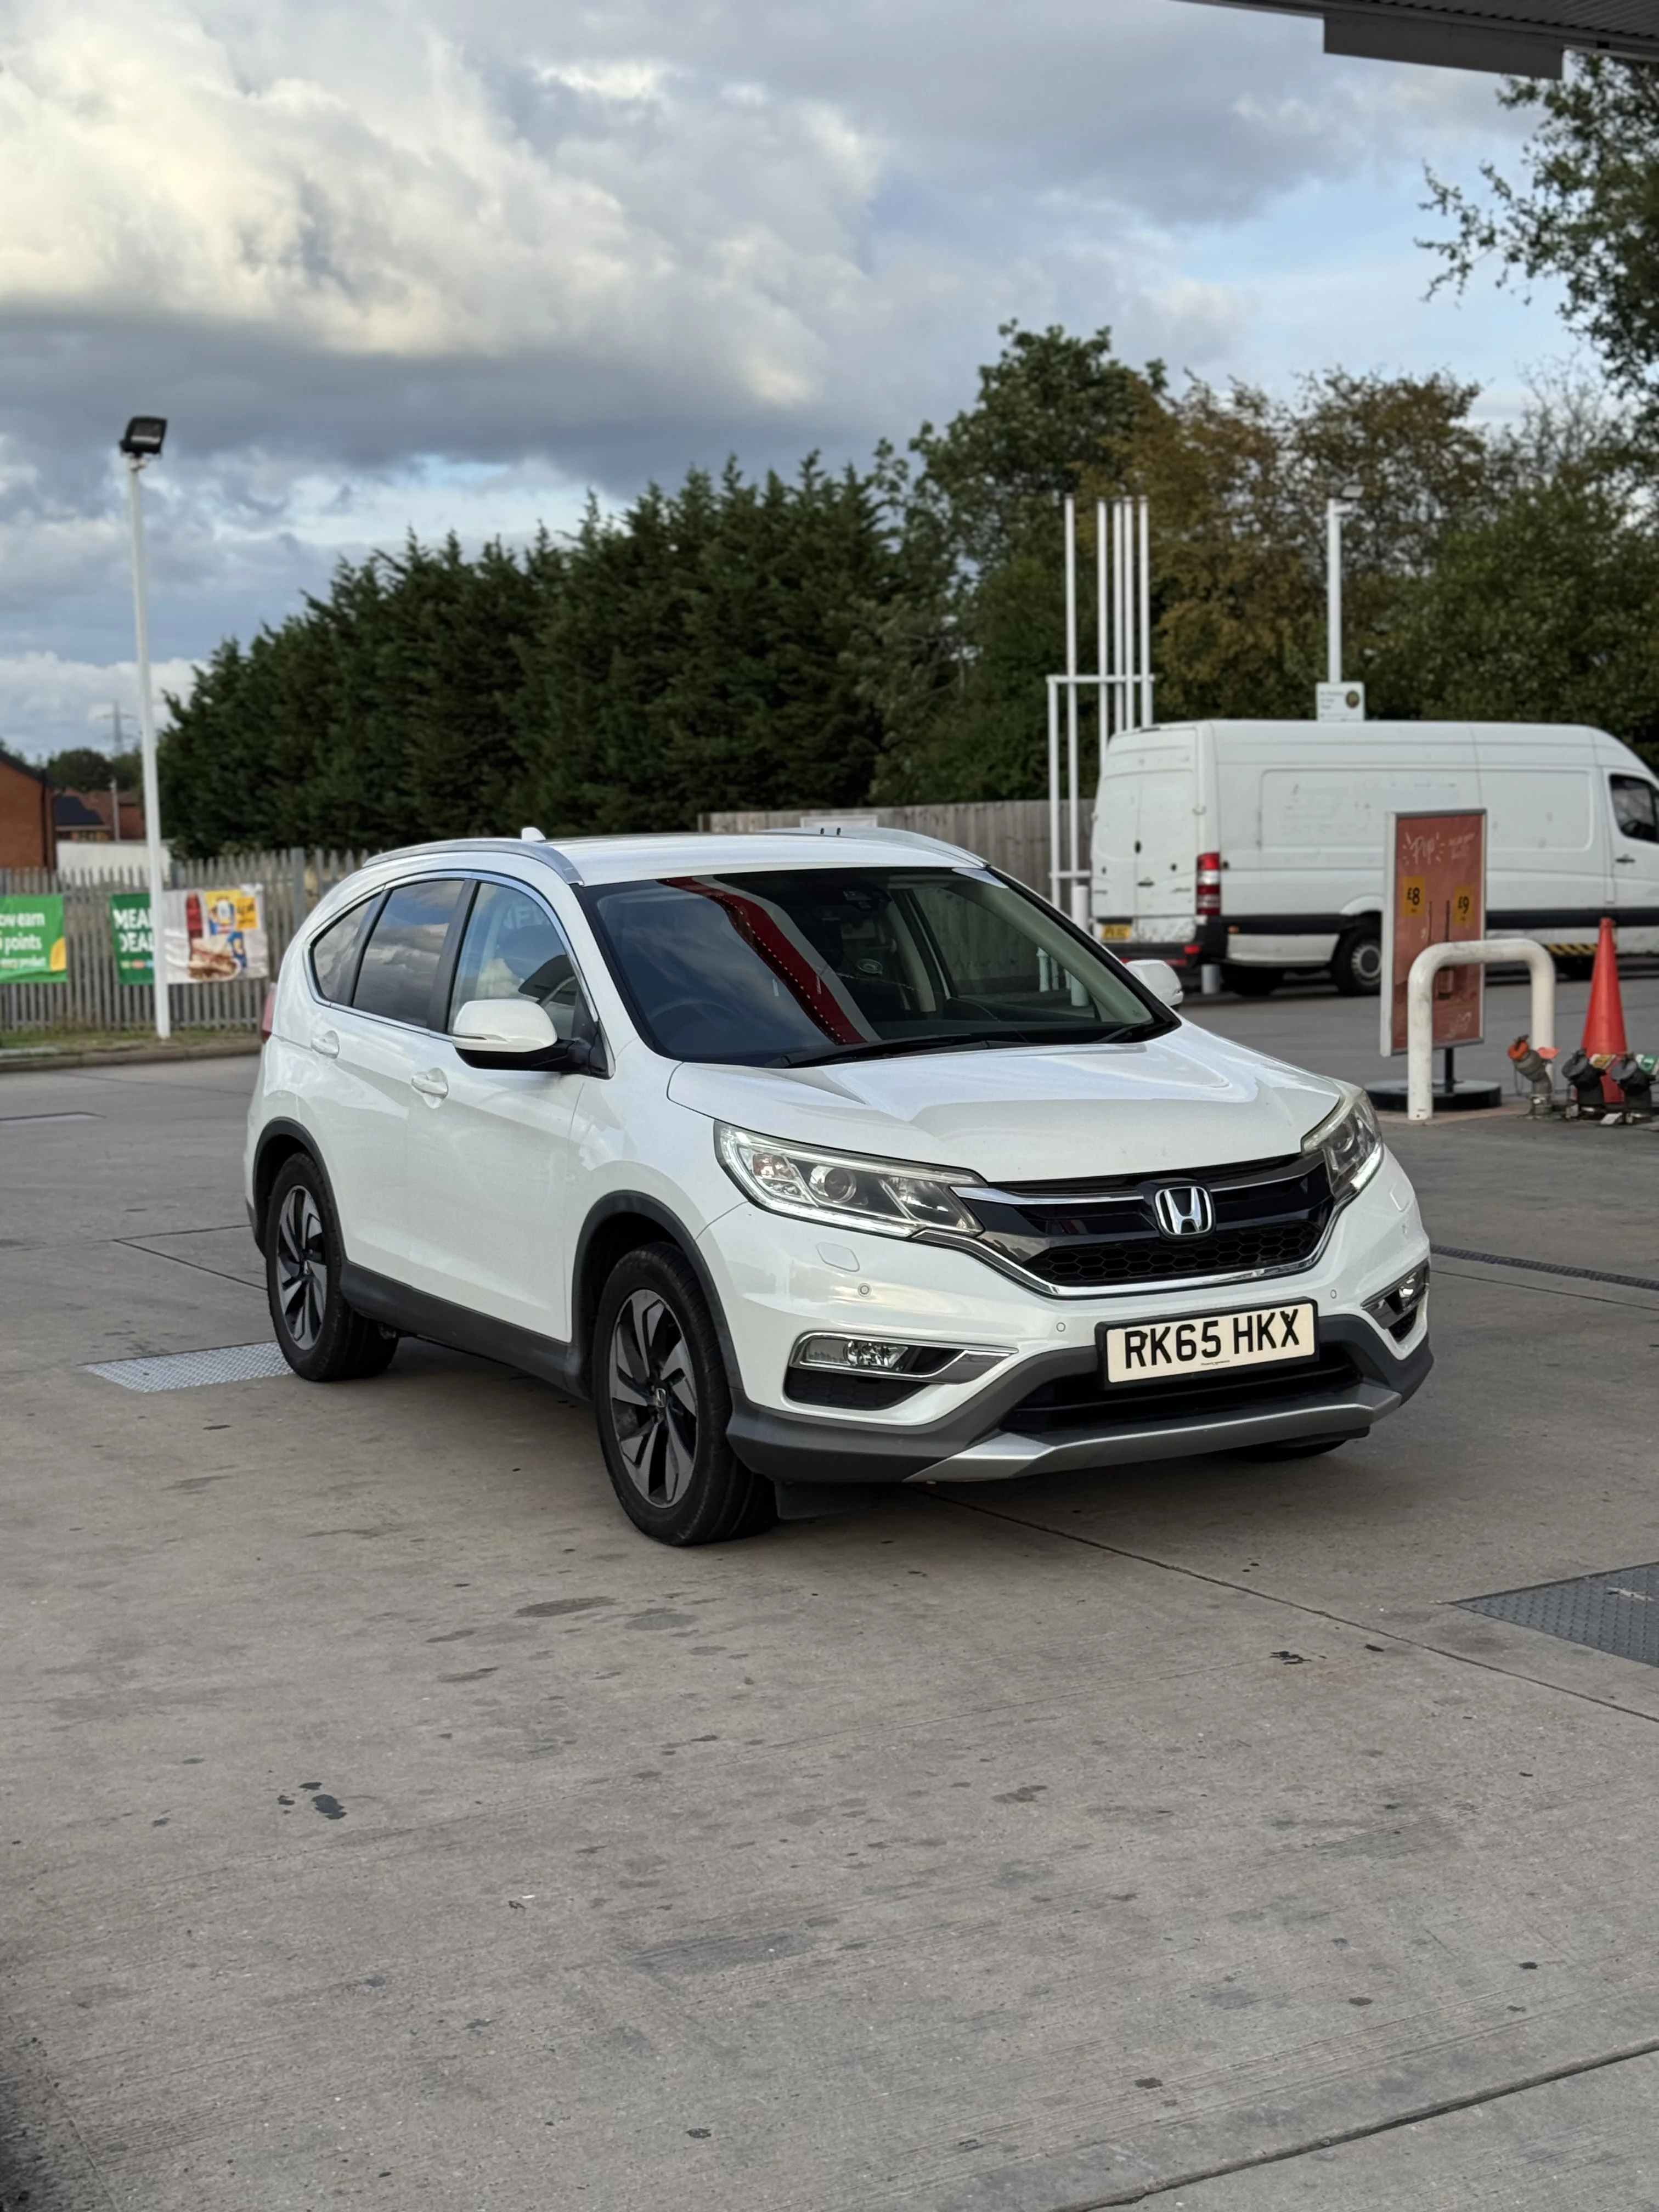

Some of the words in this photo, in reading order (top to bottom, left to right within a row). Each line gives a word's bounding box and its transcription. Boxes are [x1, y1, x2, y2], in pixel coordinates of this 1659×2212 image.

[1407, 887, 1420, 906] £8
[1458, 896, 1469, 914] £9
[17, 912, 46, 927] earn
[4, 932, 42, 956] points
[1125, 1319, 1222, 1369] RK65
[1233, 1308, 1300, 1355] HKX
